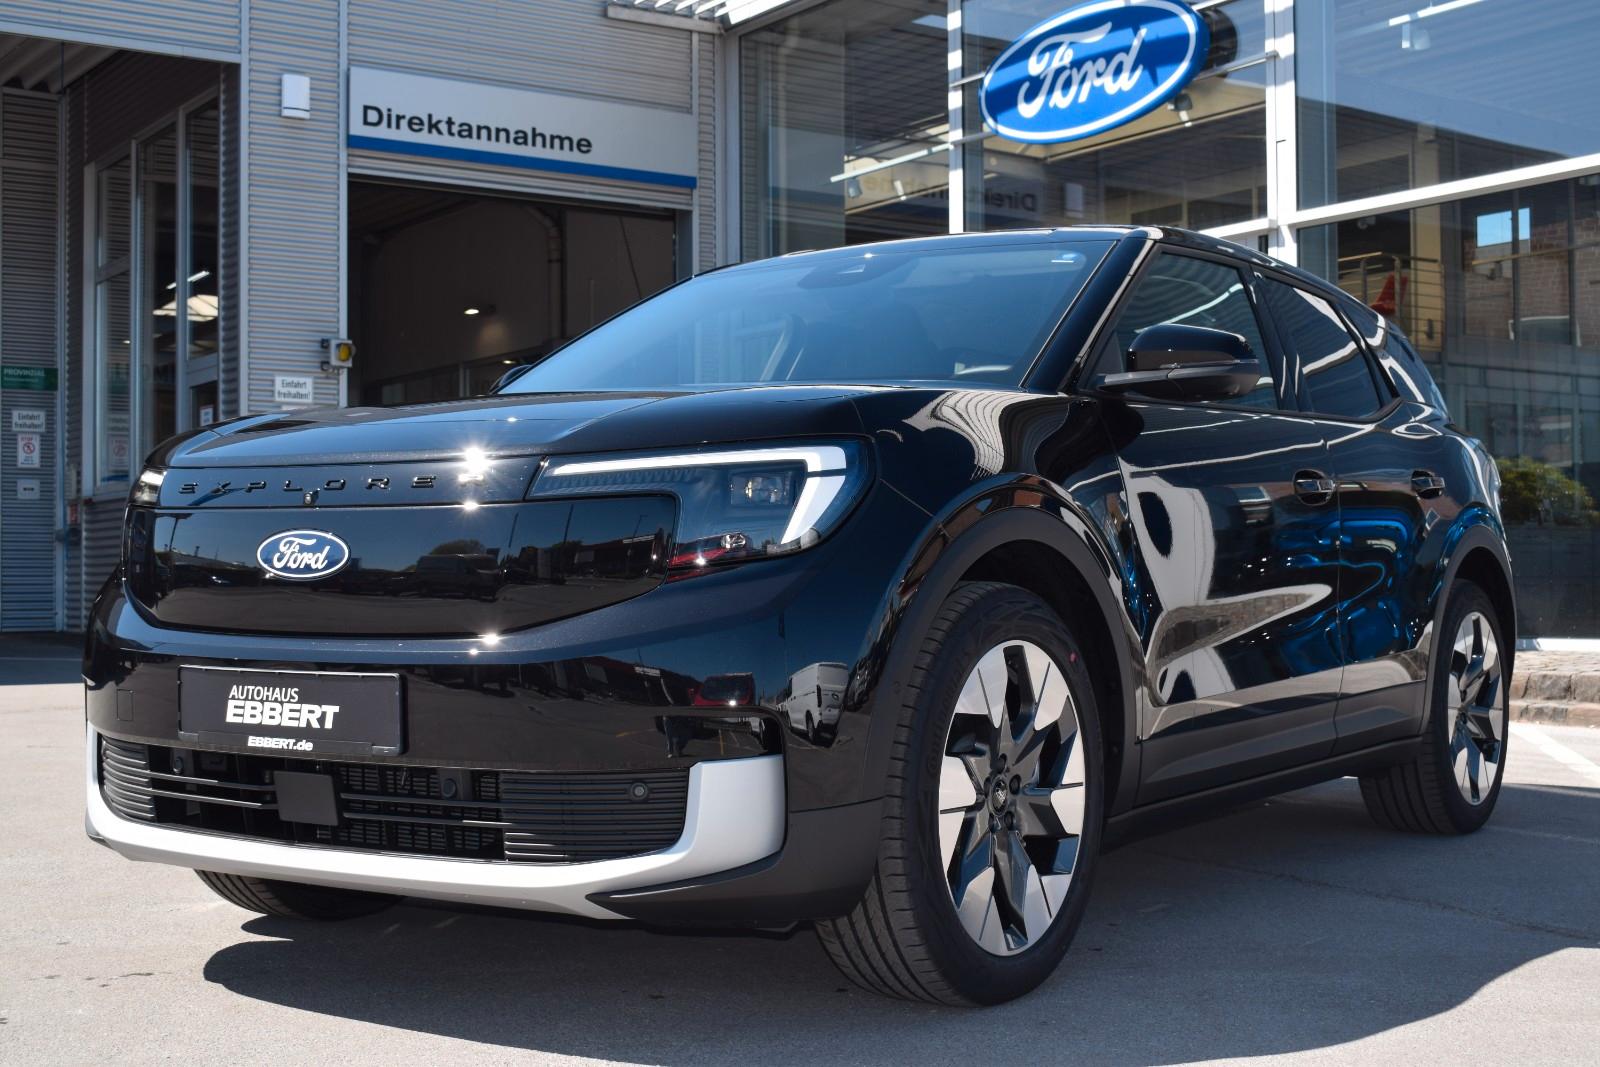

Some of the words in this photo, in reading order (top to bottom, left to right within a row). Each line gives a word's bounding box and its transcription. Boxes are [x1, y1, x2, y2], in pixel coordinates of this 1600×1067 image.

[1017, 21, 1147, 119] Ford
[362, 104, 592, 154] Direktannahme
[281, 379, 307, 389] Einfahrt
[18, 412, 40, 421] Einfahrt
[272, 536, 329, 571] Ford
[228, 684, 299, 702] AUTOHAUS
[225, 700, 339, 729] EBBERT
[247, 735, 314, 751] EBBERT.de
